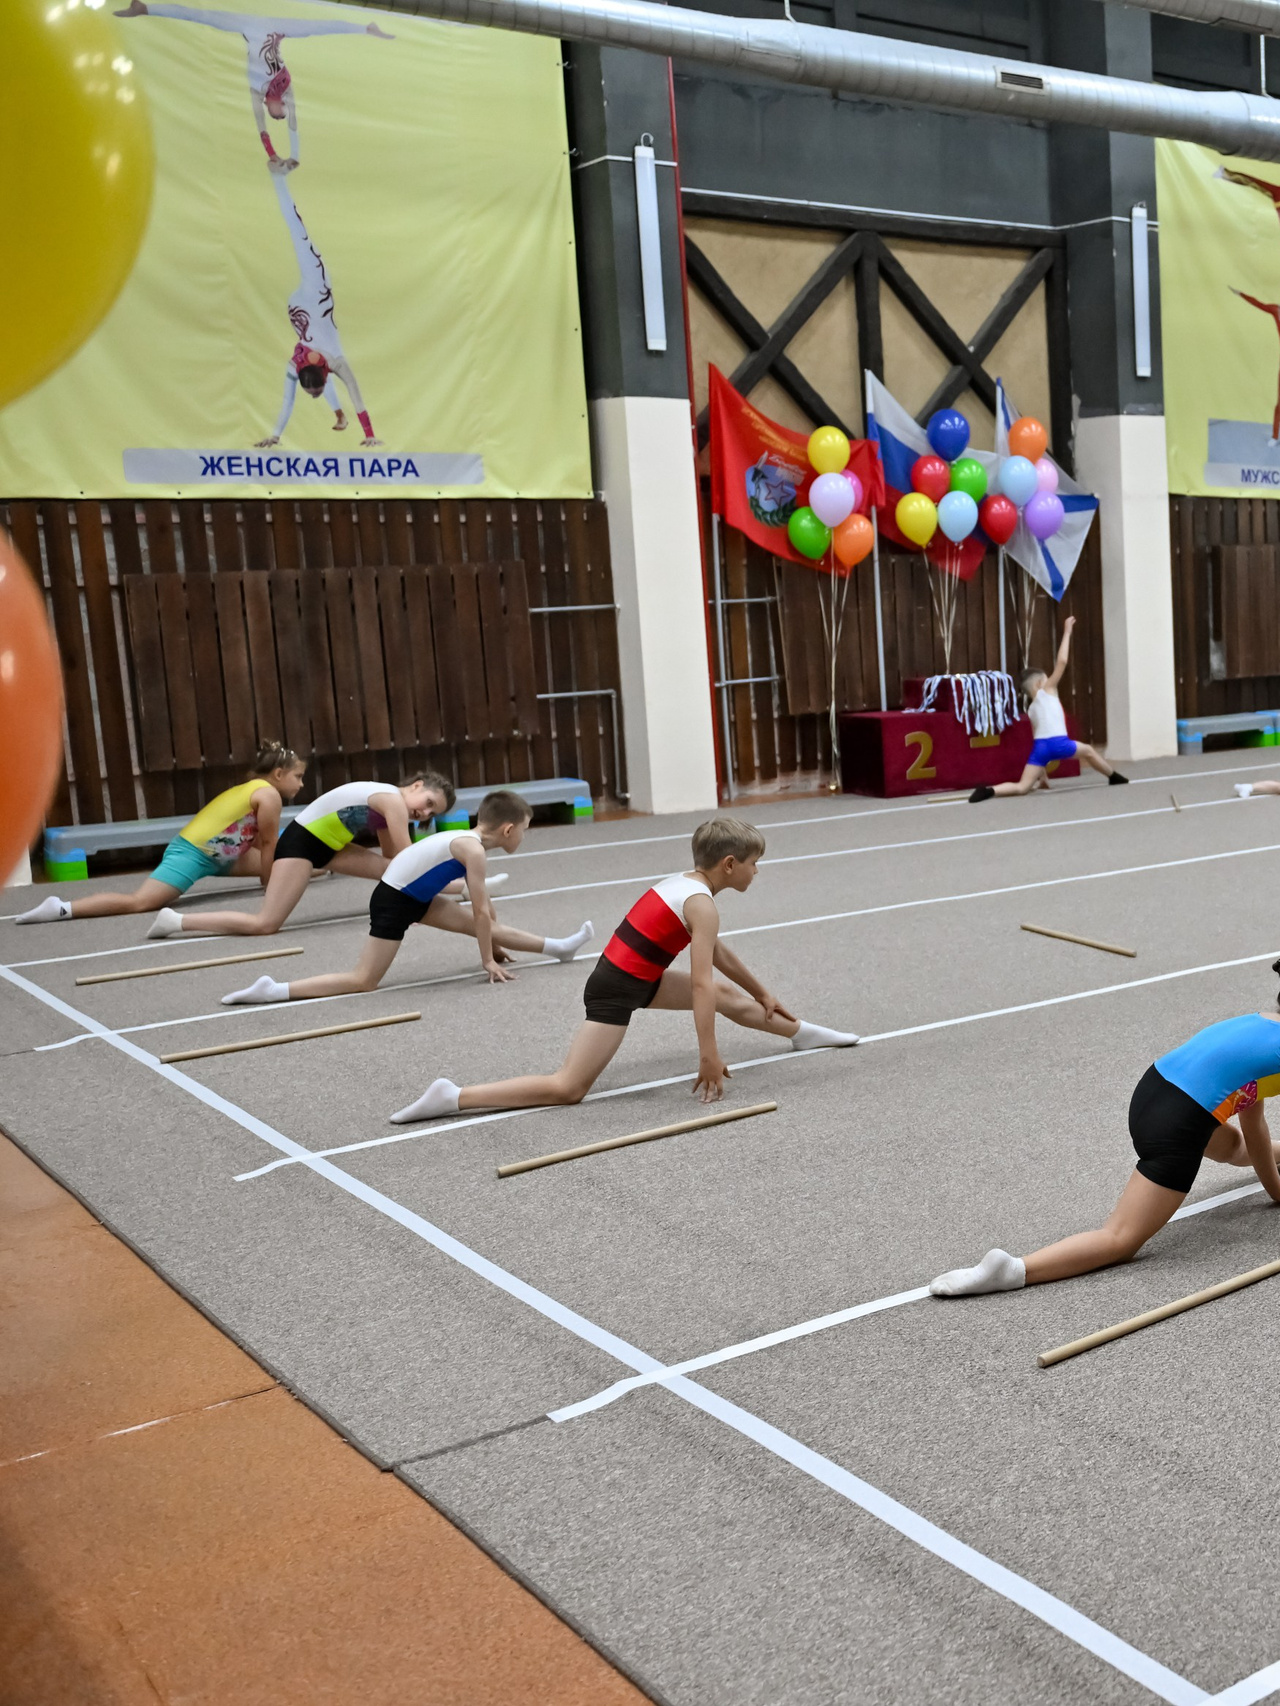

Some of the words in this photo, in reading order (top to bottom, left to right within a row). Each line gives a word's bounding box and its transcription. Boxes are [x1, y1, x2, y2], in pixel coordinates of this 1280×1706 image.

[199, 456, 340, 477] ЖЕНСКАЯ
[349, 458, 420, 477] ПАРА
[905, 731, 936, 780] 2
